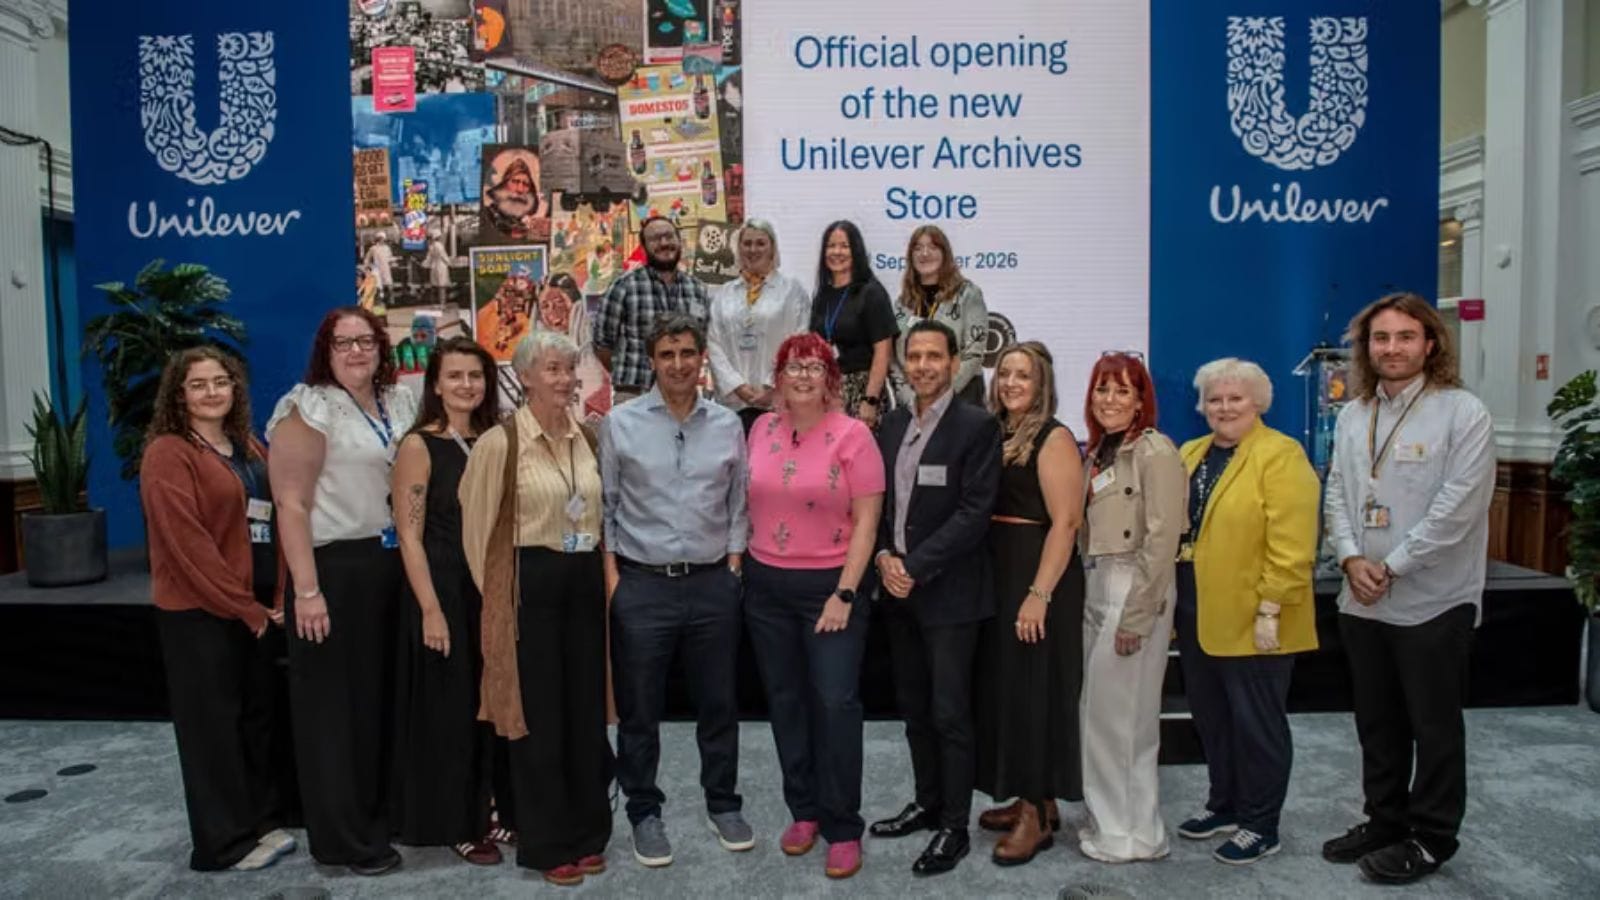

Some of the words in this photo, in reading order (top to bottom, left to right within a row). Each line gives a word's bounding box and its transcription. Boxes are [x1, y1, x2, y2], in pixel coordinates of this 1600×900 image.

[794, 34, 920, 69] Official
[930, 34, 1068, 75] opening
[628, 100, 689, 115] DOMESTOS
[840, 86, 876, 119] of
[882, 86, 939, 119] the
[949, 93, 1023, 118] new
[780, 137, 925, 170] Unilever
[932, 136, 1083, 169] Archives
[127, 196, 301, 238] Unilever
[885, 187, 978, 219] Store
[1209, 181, 1389, 223] Unilever
[479, 251, 539, 262] SUNLIGHT
[479, 263, 512, 274] SOAP
[876, 253, 971, 271] Seper
[975, 252, 1018, 269] 2026
